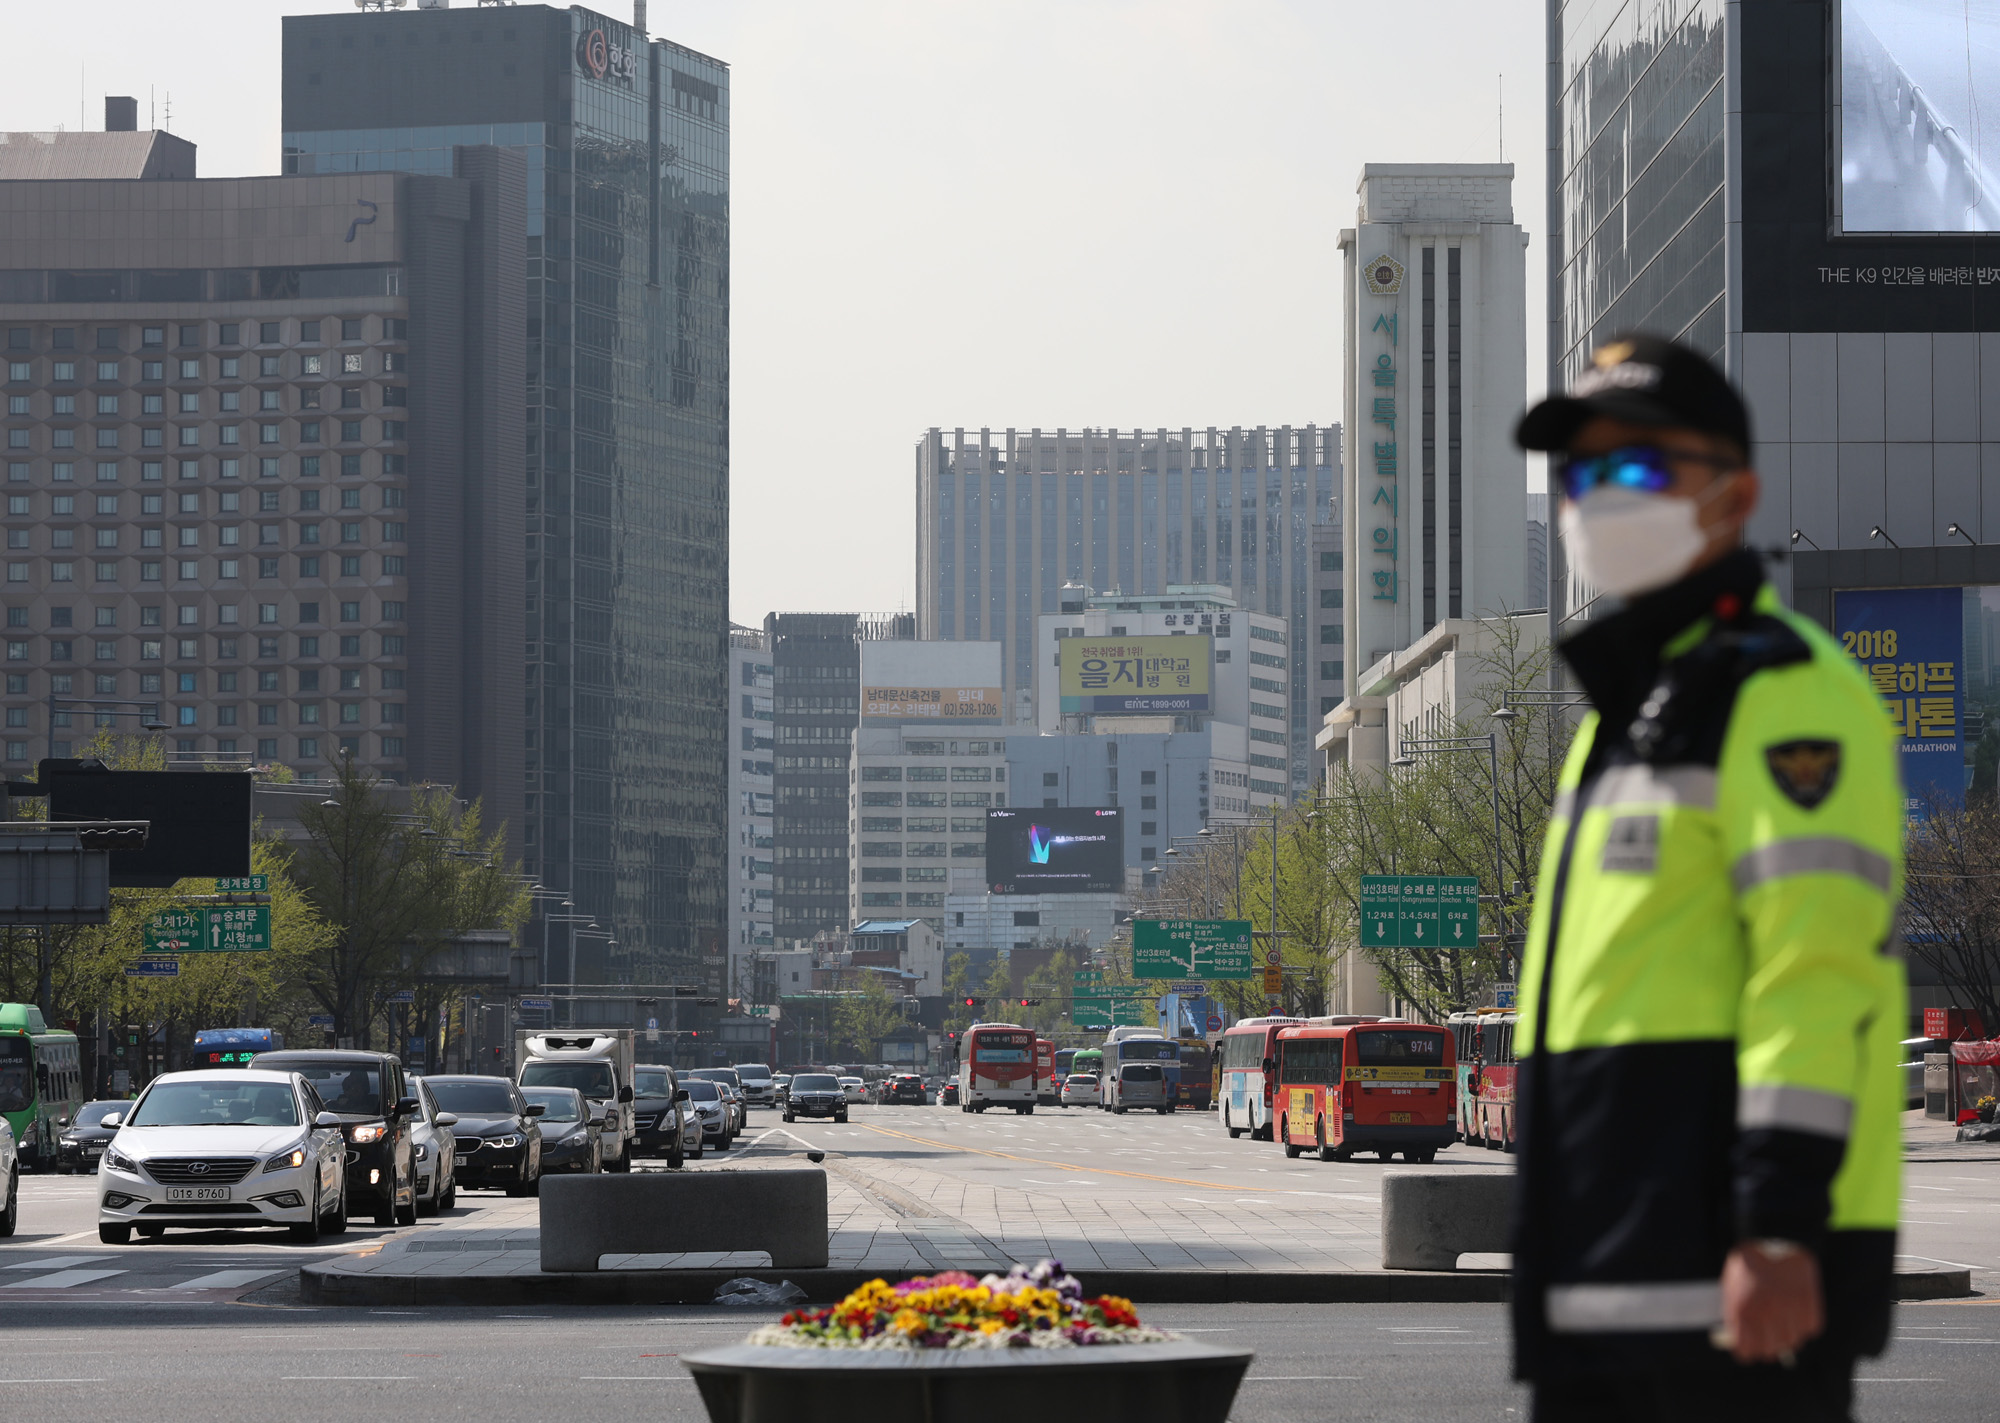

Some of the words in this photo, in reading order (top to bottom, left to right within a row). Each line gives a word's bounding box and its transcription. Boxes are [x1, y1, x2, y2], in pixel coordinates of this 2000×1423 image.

[608, 43, 637, 83] 한화
[1377, 270, 1394, 281] 의회
[1818, 267, 1850, 283] THE
[1856, 267, 1877, 284] K9
[1882, 267, 1926, 285] 인간을
[1930, 267, 1974, 285] 배려한
[1371, 312, 1398, 603] 서울특별시의회
[1164, 613, 1231, 626] 삼정빌딩
[1842, 629, 1898, 660] 2018
[1081, 647, 1099, 657] 전국
[1100, 646, 1125, 657] 취업률
[1127, 646, 1143, 656] 1위!
[1146, 658, 1190, 671] 대학교
[1078, 658, 1144, 689] 을지
[867, 689, 942, 702] 남대문신축건물
[957, 689, 984, 702] 임대
[1884, 697, 1956, 738] 라톤
[1901, 743, 1957, 753] MARATHON
[220, 877, 262, 890] 청계광장
[1004, 884, 1015, 892] LG
[1362, 884, 1399, 895] 남산3호터널
[1404, 885, 1436, 895] 숭례문
[1441, 885, 1477, 895] 신촌로터리
[1402, 896, 1438, 904] Sungnyemun
[223, 910, 258, 922] 숭례문
[1367, 911, 1395, 920] 1.2차로
[1401, 911, 1438, 920] 3.4.5차로
[1448, 912, 1469, 920] 6차로
[1170, 922, 1192, 930] 서울역
[224, 931, 246, 943] 시청
[1170, 932, 1192, 940] 숭례문
[1136, 948, 1171, 957] 남산3호터널
[1215, 943, 1249, 951] 신촌로터리
[1269, 954, 1278, 962] 60
[1011, 1035, 1028, 1044] 1200
[1411, 1040, 1433, 1053] 9714
[209, 1053, 220, 1062] 150
[172, 1188, 193, 1199] 01호
[197, 1188, 224, 1199] 8760
